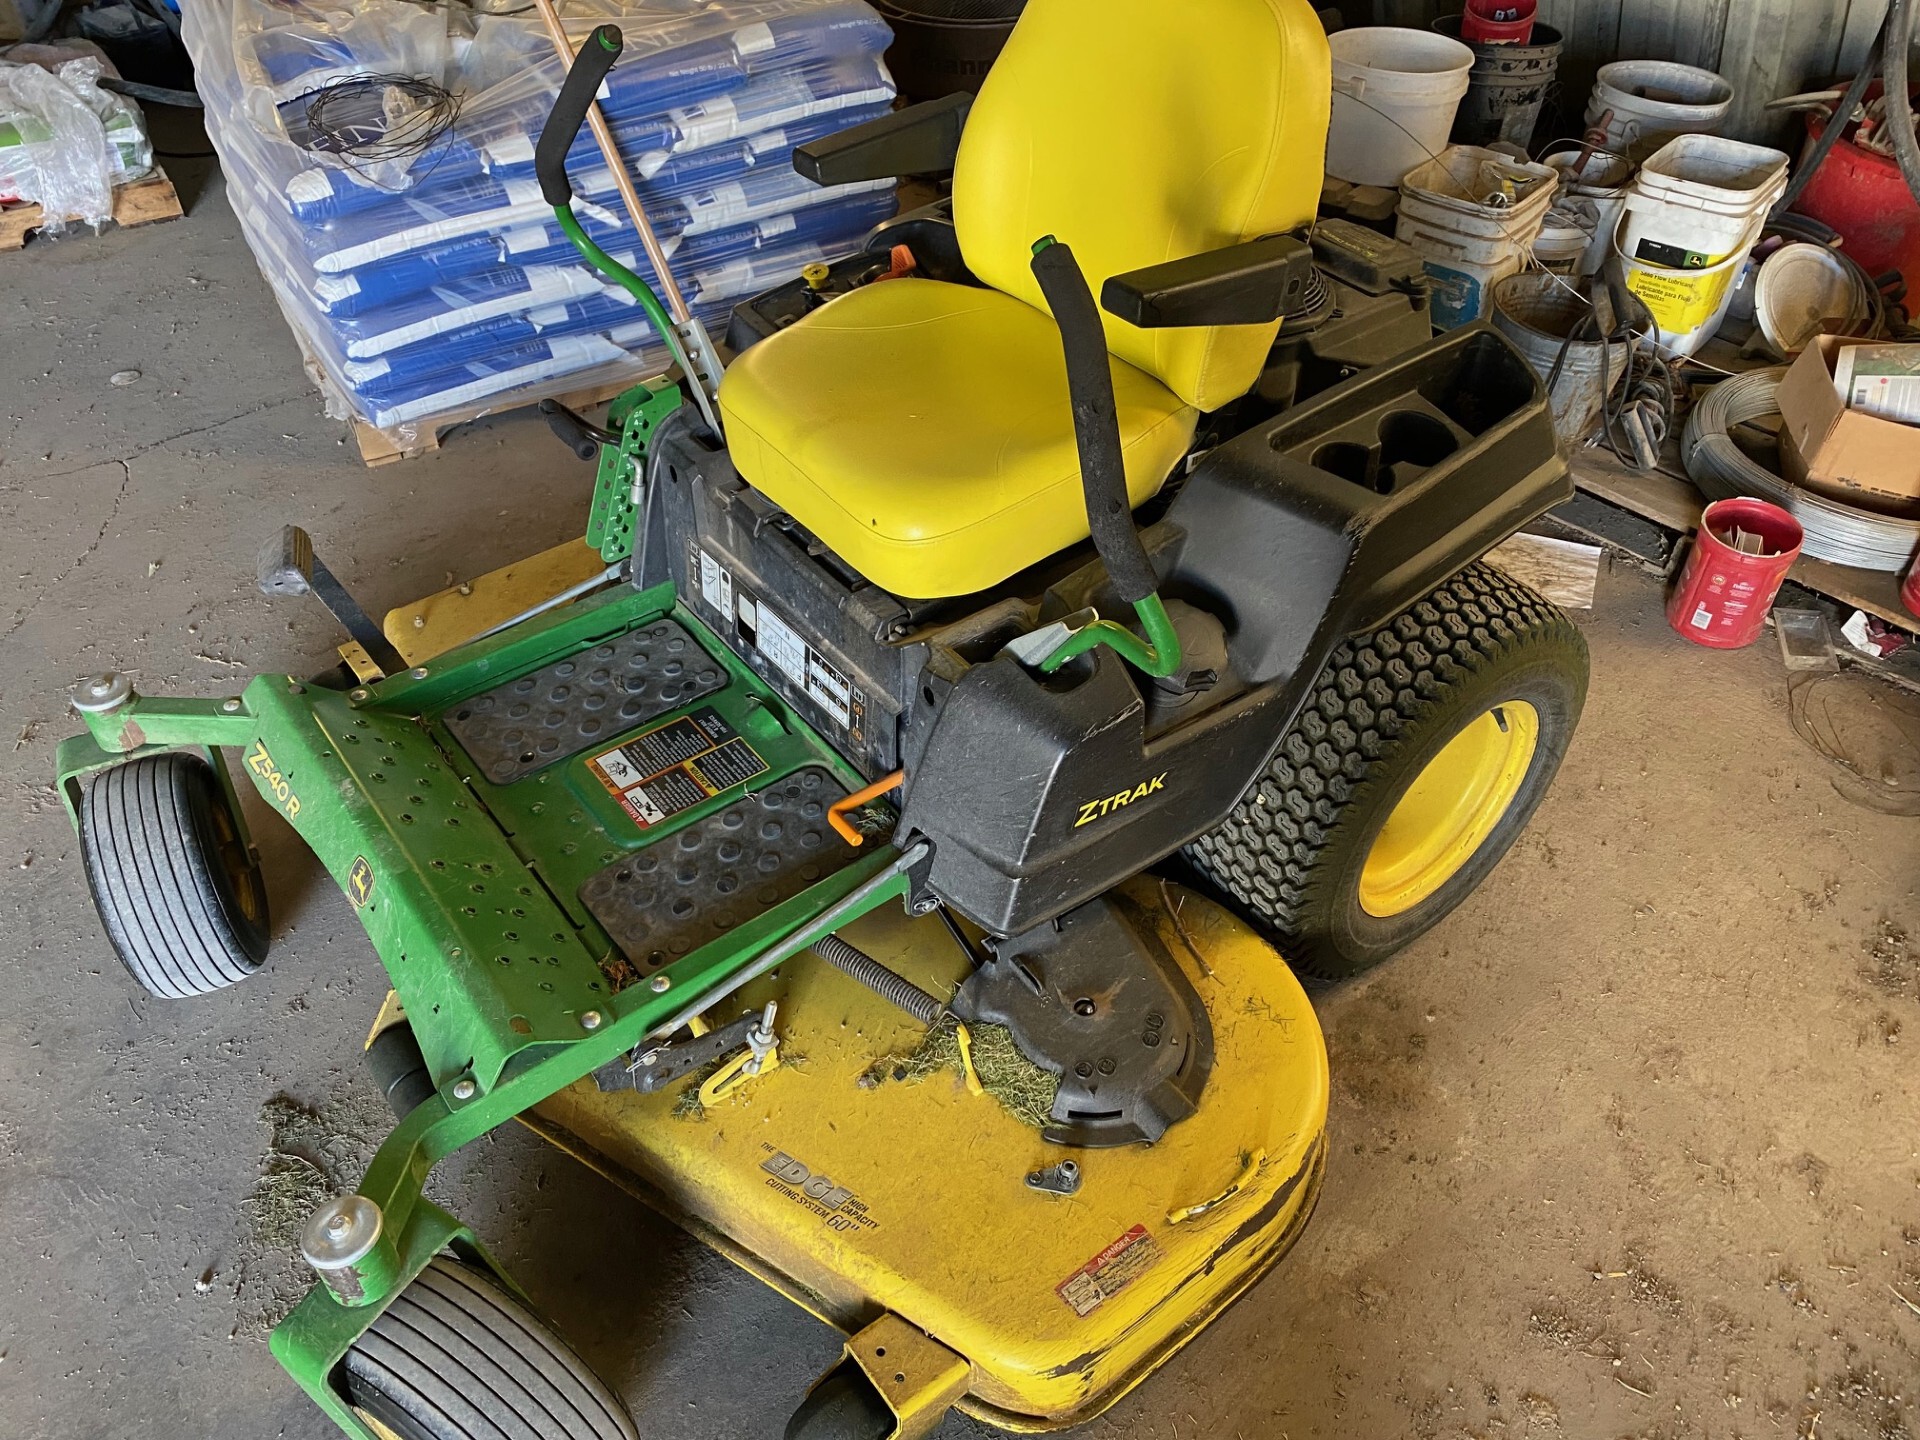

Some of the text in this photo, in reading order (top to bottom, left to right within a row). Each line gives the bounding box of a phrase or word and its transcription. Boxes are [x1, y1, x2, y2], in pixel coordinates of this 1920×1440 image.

[1636, 283, 1664, 295] Lubricante
[1664, 291, 1677, 299] para
[1668, 277, 1694, 289] Lubricant
[1642, 290, 1665, 302] Semillas
[620, 798, 640, 818] DANGER
[1074, 771, 1168, 828] ZTRAK
[760, 1141, 776, 1153] THE
[758, 1148, 855, 1212] EDGE
[765, 1178, 800, 1200] CUTTING
[796, 1196, 831, 1219] SYSTEM
[848, 1198, 870, 1214] HIGH
[840, 1205, 880, 1230] CAPACITY
[1102, 1236, 1131, 1260] DANGER
